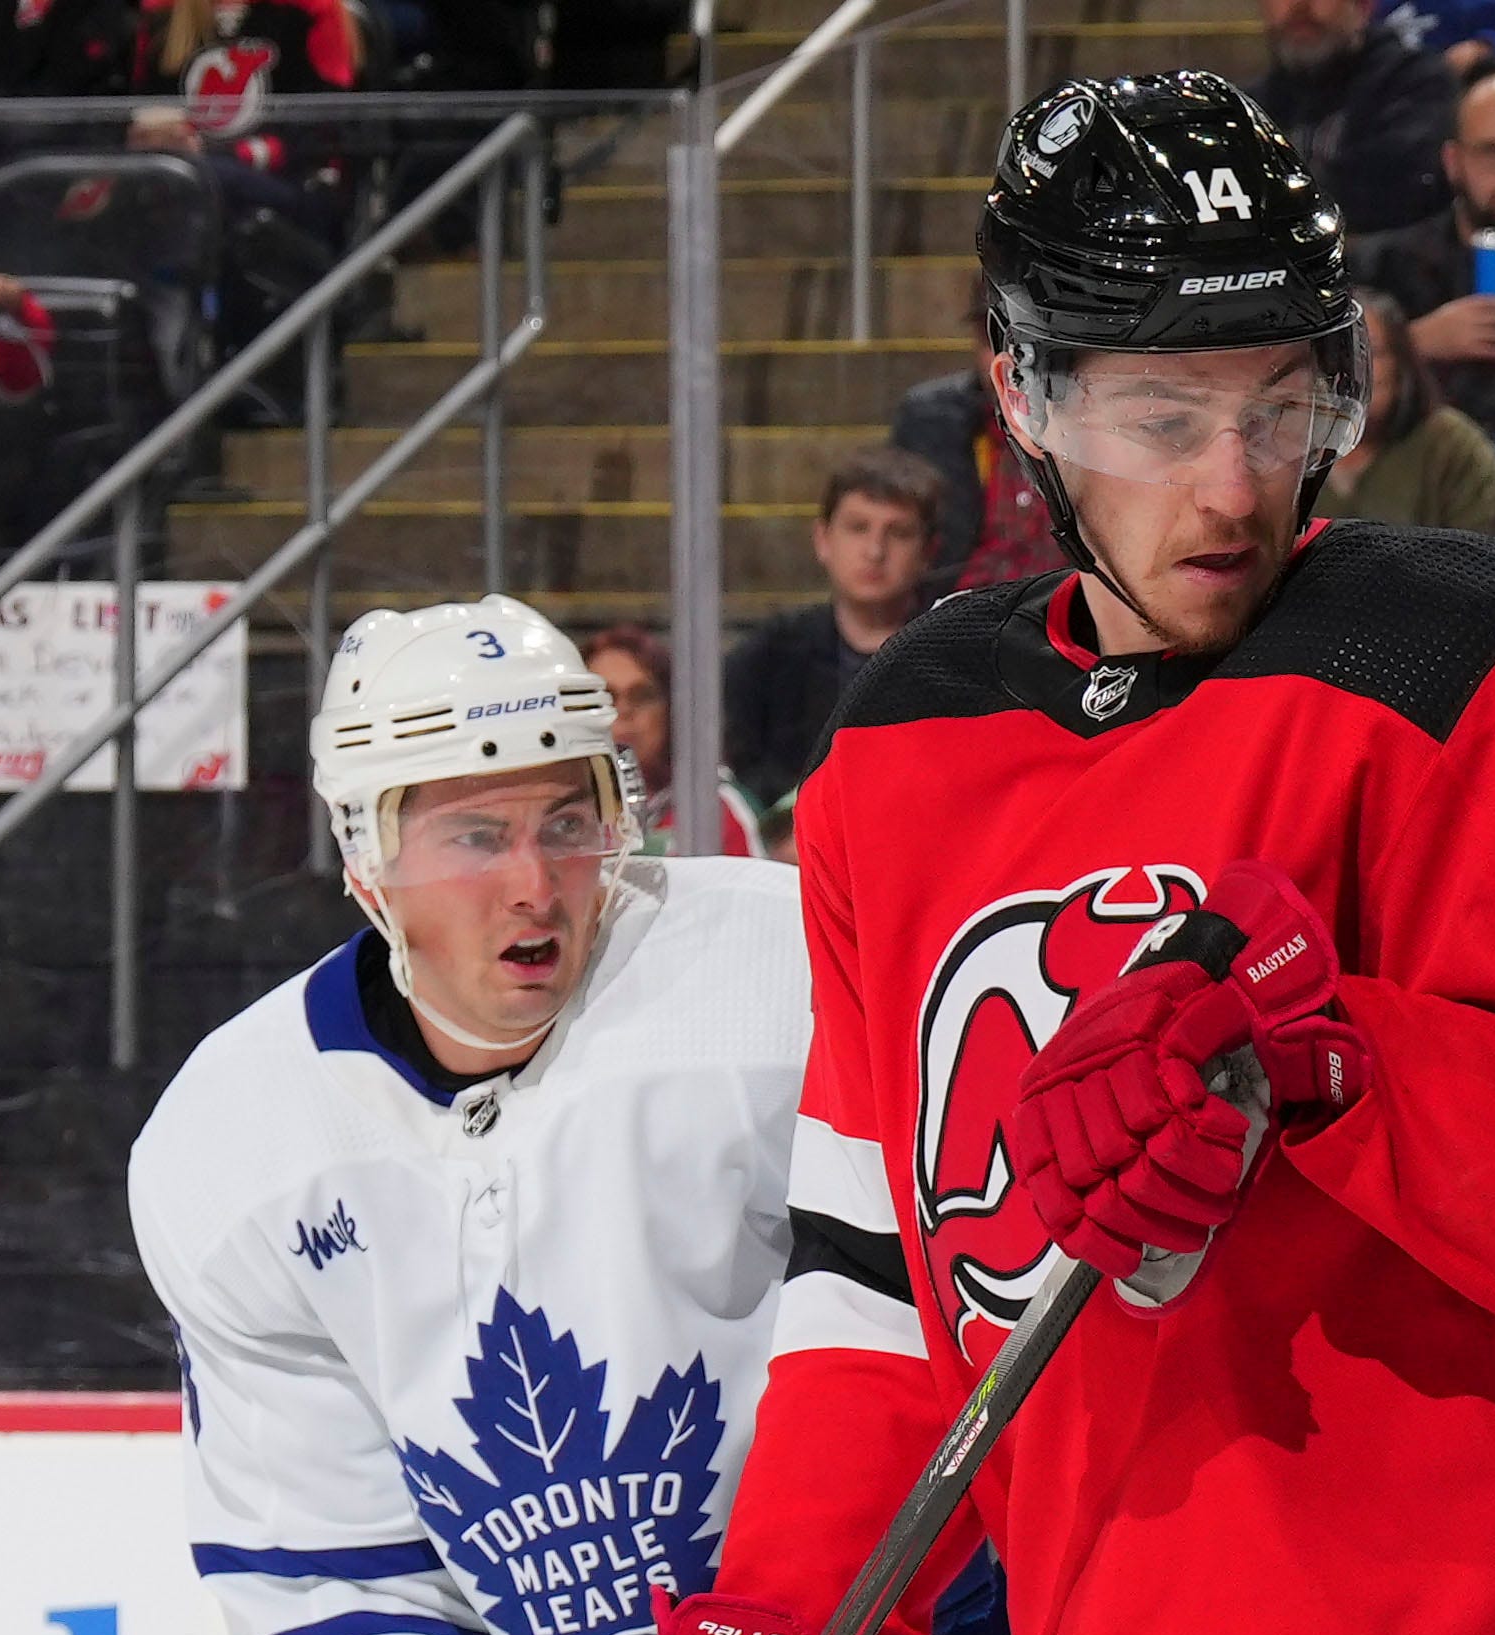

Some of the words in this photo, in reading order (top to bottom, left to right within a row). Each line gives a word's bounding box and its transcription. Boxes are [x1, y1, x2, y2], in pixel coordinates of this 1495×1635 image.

[1182, 167, 1253, 224] 14
[1178, 269, 1288, 296] BAUER
[466, 629, 506, 659] 3
[466, 695, 557, 721] BAUER
[1245, 933, 1309, 985] BASTIAN
[461, 1471, 683, 1566] TORONTO
[507, 1517, 666, 1596] MAPLE
